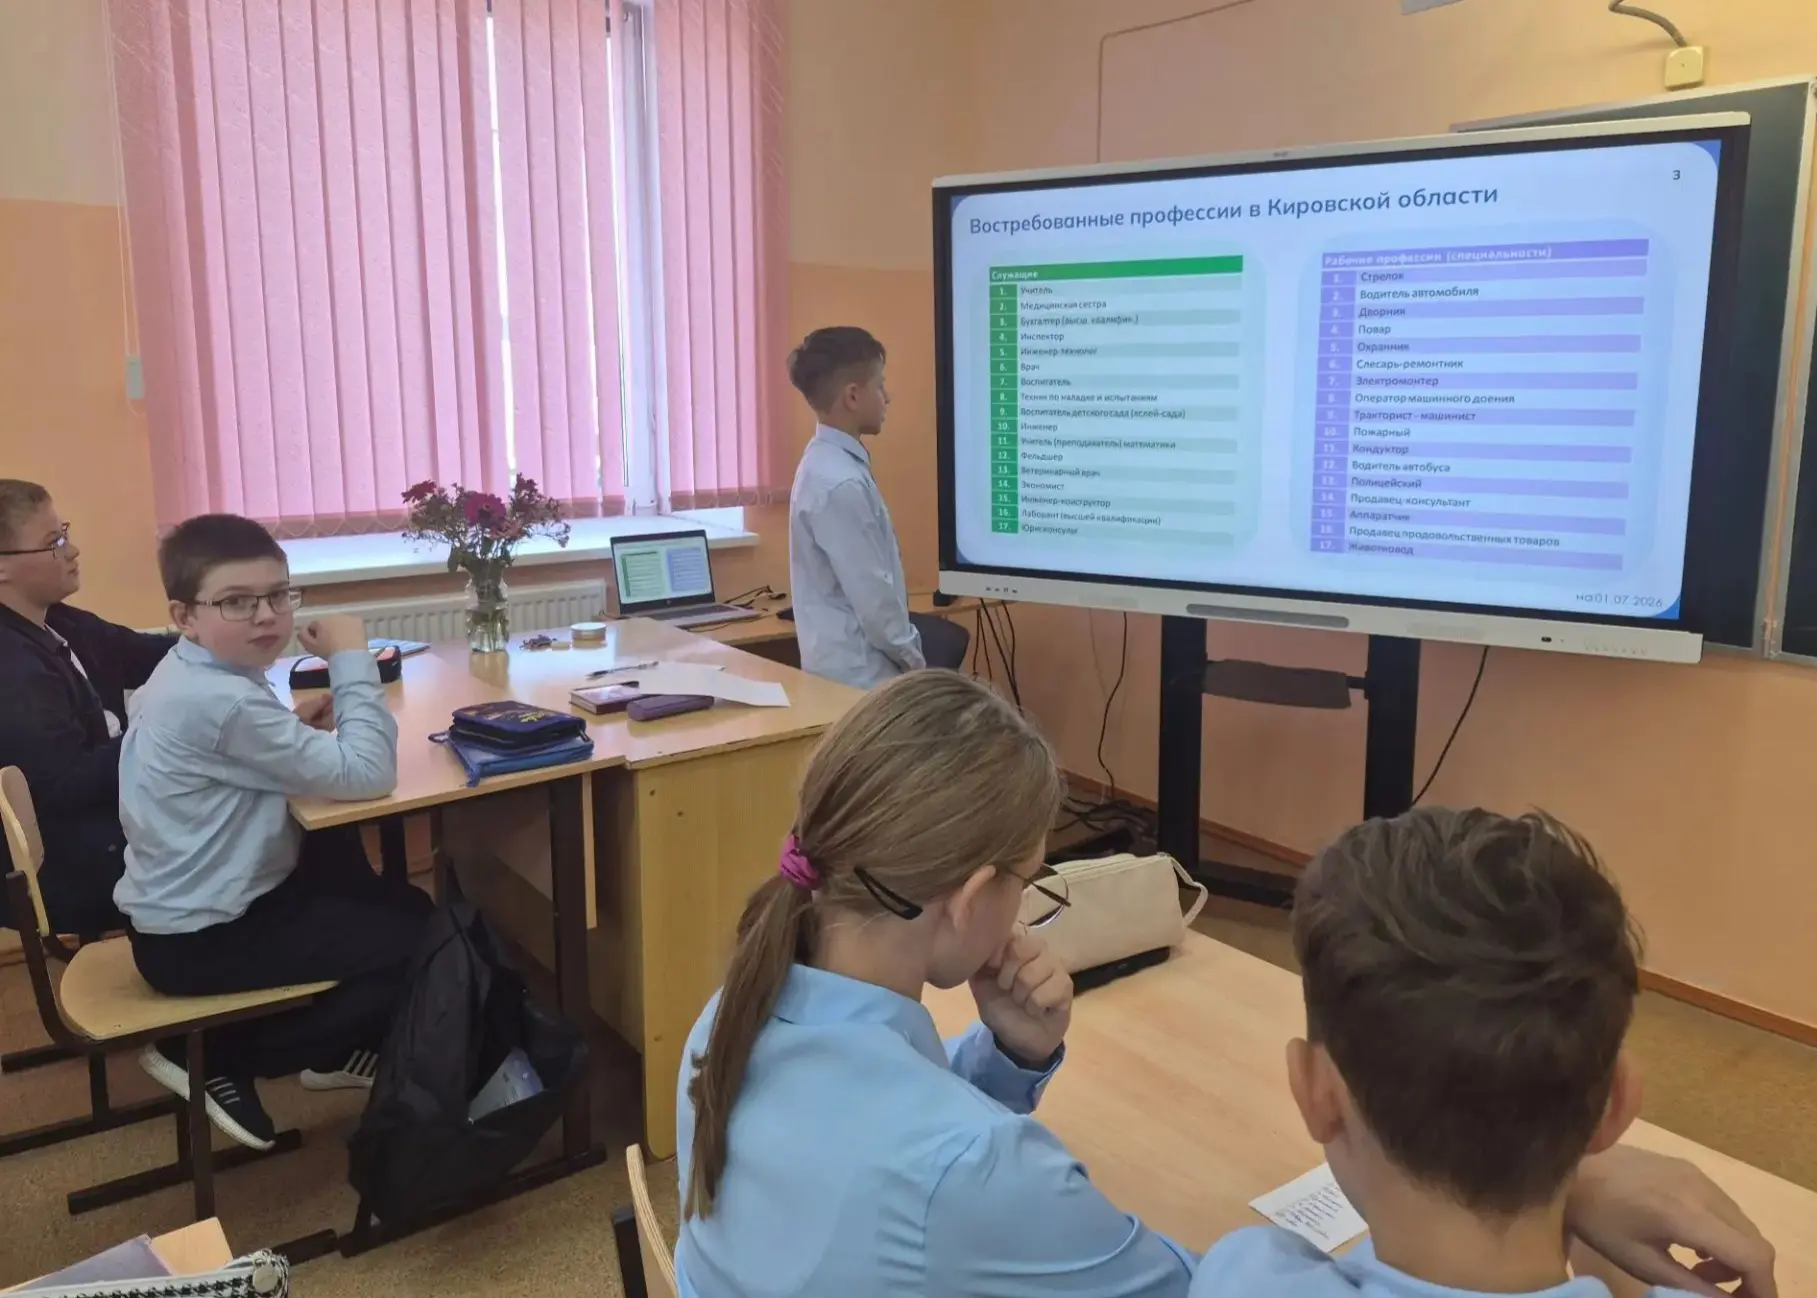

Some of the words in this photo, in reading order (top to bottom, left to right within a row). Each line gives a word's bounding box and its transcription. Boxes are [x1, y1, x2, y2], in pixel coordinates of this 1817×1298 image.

[1672, 169, 1682, 181] 3
[969, 213, 1124, 236] Востребованные
[1130, 204, 1242, 228] профессии
[1249, 204, 1262, 218] в
[1267, 191, 1391, 219] Кировской
[1398, 186, 1499, 208] области
[1376, 253, 1441, 267] профессии
[1447, 247, 1552, 263] (специальности)
[991, 270, 1038, 281] Служащие
[1361, 272, 1403, 283] Стрелок
[1020, 287, 1053, 295] Учитель
[1360, 289, 1410, 300] Водитель
[1412, 286, 1479, 298] автомобиля
[1020, 302, 1077, 311] Медицинская
[1078, 300, 1107, 309] сестра
[1358, 307, 1405, 318] Дворник
[1358, 325, 1390, 336] Повар
[1020, 333, 1065, 342] Инспектор
[1020, 363, 1040, 372] Врач
[1356, 359, 1463, 370] Слесарь-ремонтник
[1020, 378, 1071, 387] Воспитатель
[1356, 375, 1439, 387] Электромонтер
[1354, 393, 1407, 404] Оператор
[1409, 394, 1471, 404] машинного
[1472, 394, 1515, 404] доения
[1109, 409, 1129, 418] сада
[1354, 410, 1412, 422] Тракторист
[1420, 412, 1476, 421] машинист
[1020, 423, 1058, 432] Инженер
[1354, 427, 1410, 438] Пожарный
[1352, 444, 1409, 455] Кондуктор
[1020, 452, 1063, 462] Фельдшер
[1352, 460, 1401, 472] Водитель
[1402, 462, 1451, 473] автобуса
[1021, 481, 1064, 490] Экономист
[1351, 476, 1421, 488] Полицейский
[1349, 526, 1401, 539] Продавец
[1513, 535, 1560, 547] товаров
